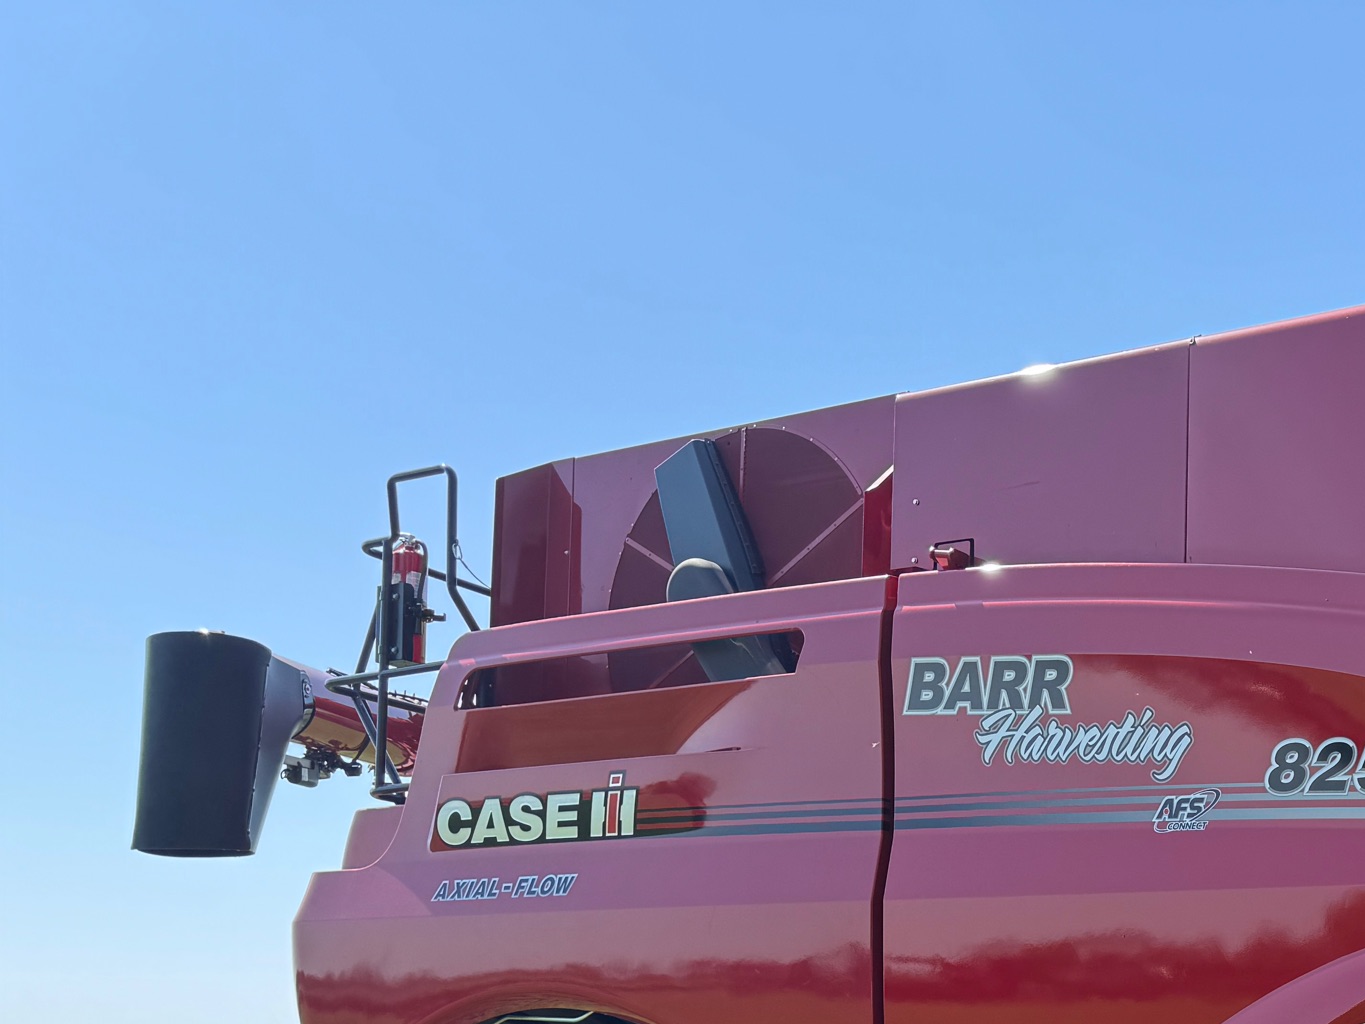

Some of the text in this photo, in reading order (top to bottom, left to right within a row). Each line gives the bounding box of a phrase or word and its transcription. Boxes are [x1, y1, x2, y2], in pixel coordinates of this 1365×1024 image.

[902, 655, 1073, 716] BARR
[974, 704, 1194, 783] Harvesting
[436, 792, 581, 846] CASE
[1152, 794, 1207, 822] AFS
[1167, 820, 1208, 831] CONNECT
[431, 873, 578, 901] AXIAL-FLOW
